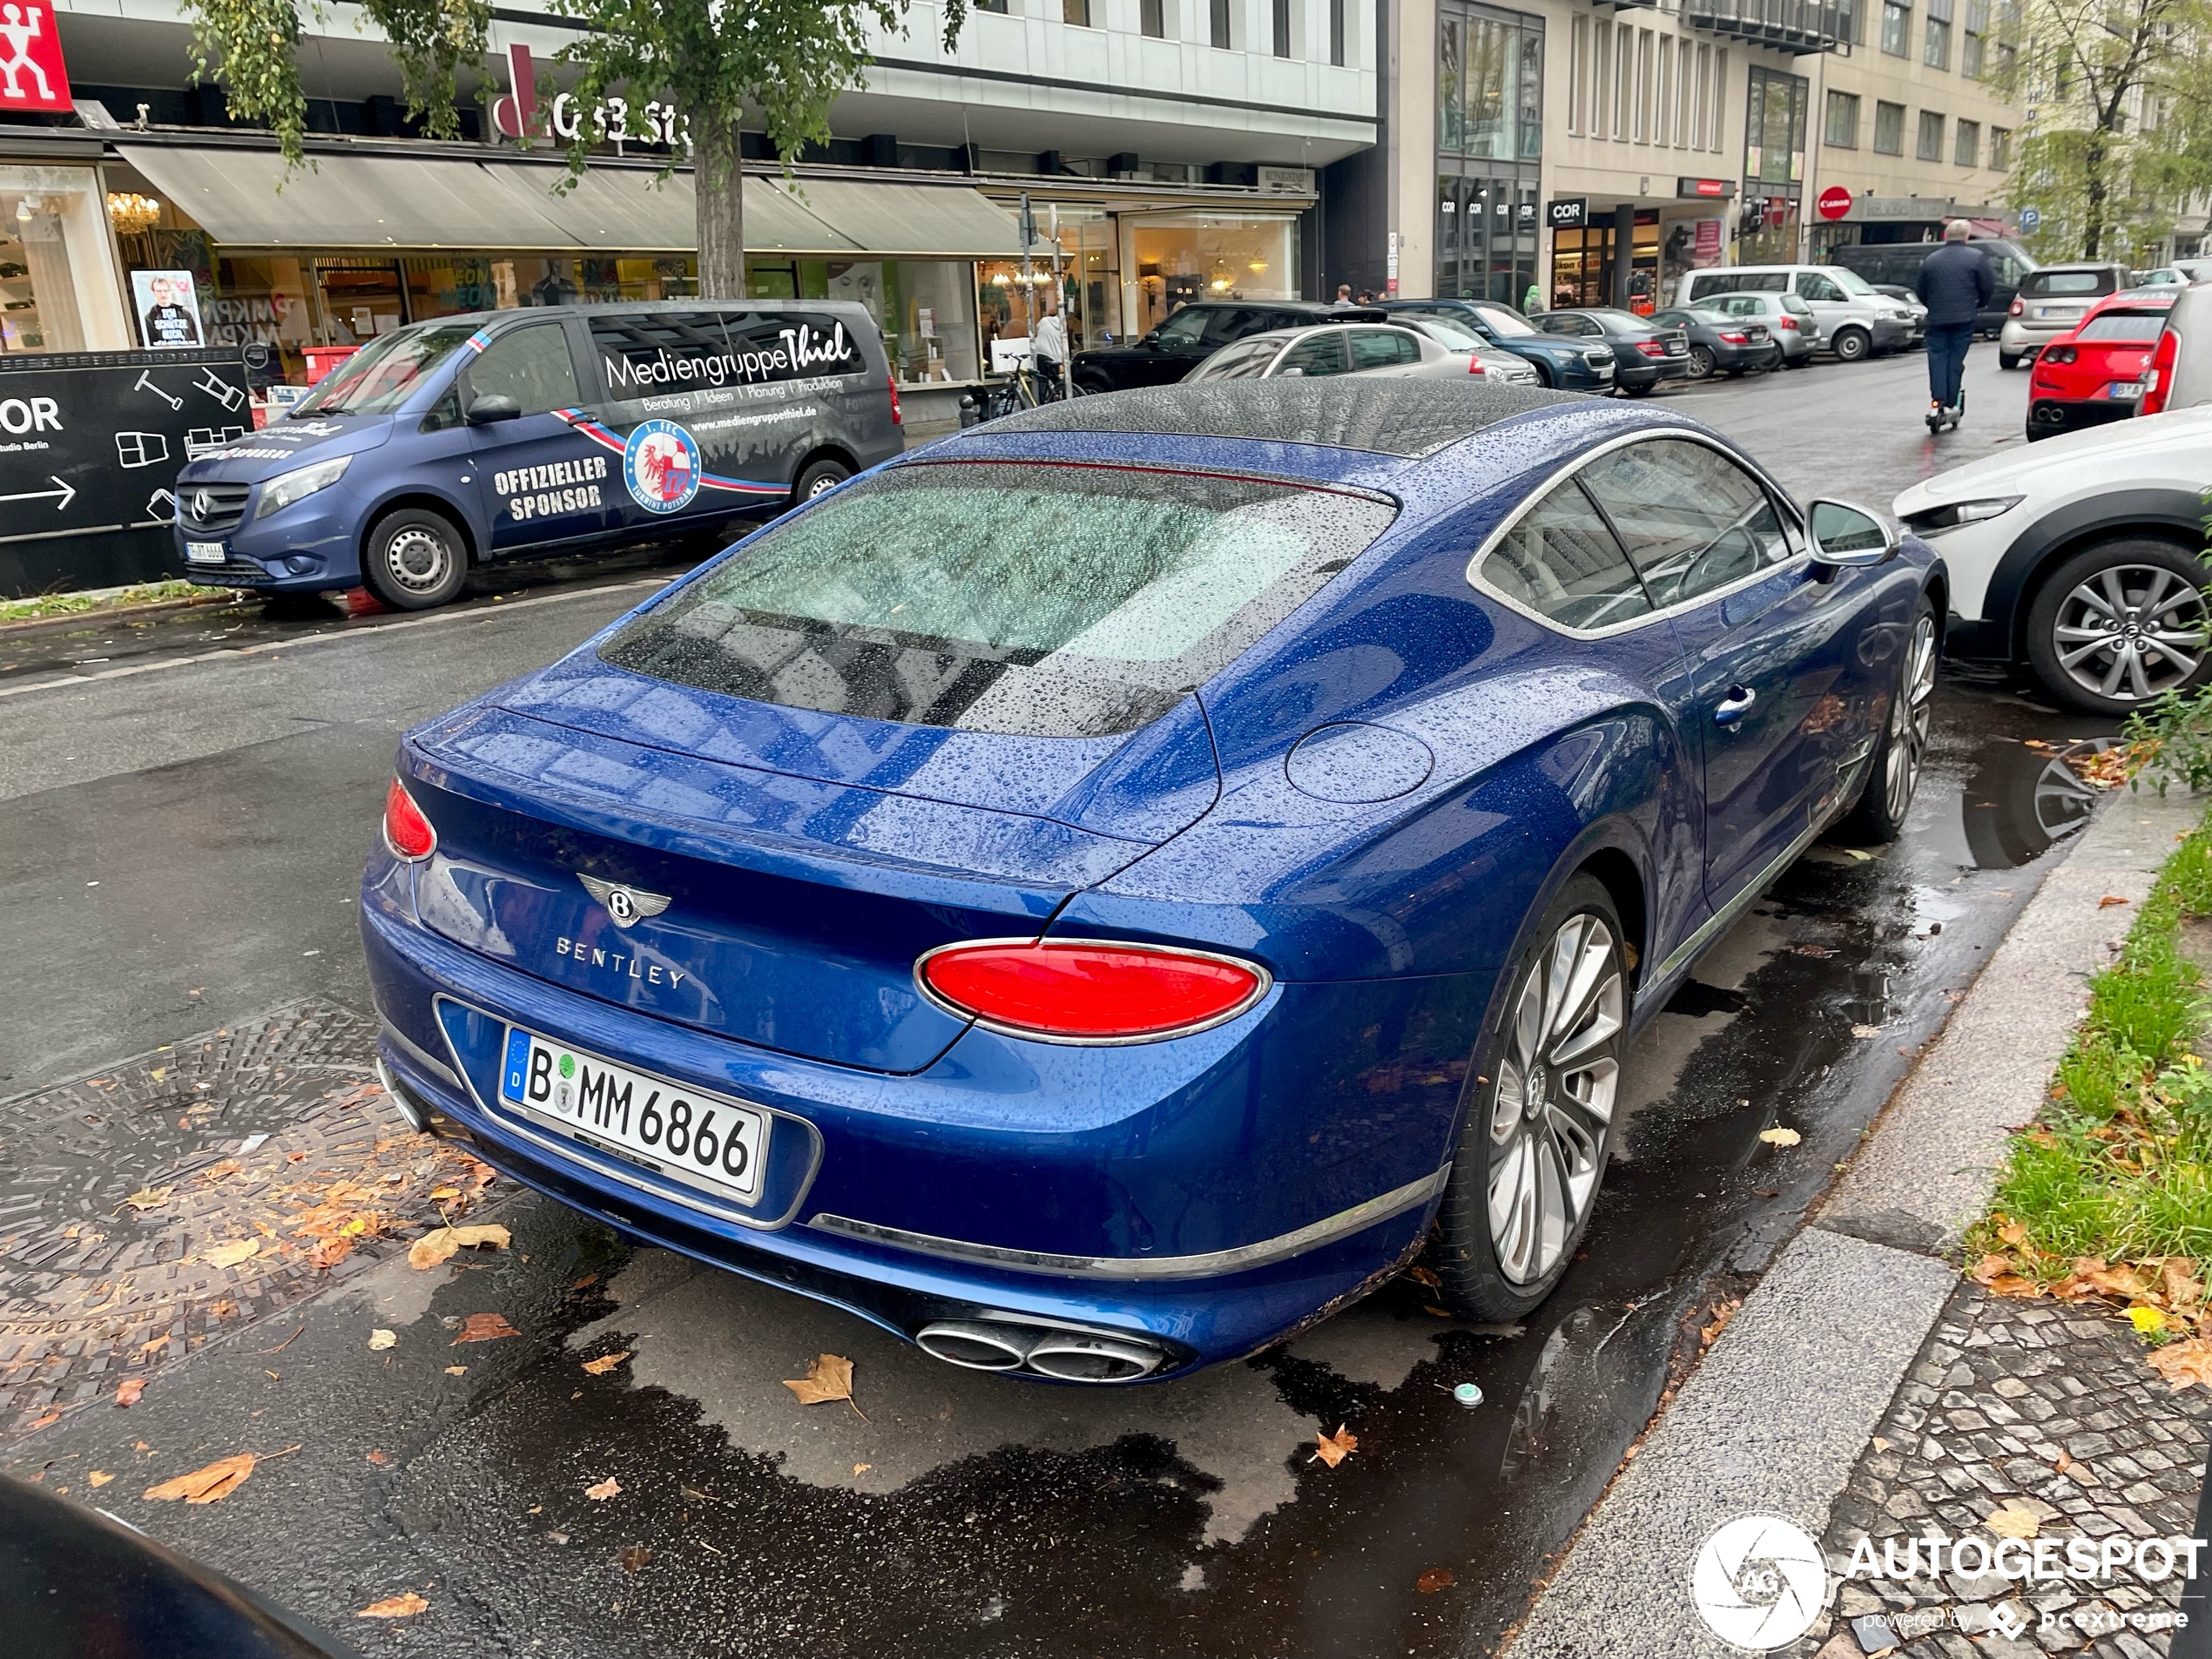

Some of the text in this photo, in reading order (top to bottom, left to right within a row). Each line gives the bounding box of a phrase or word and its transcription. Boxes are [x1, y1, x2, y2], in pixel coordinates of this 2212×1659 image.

[1442, 201, 1455, 212] COR
[1469, 203, 1481, 213] COR
[1496, 204, 1508, 215] COR
[1553, 203, 1581, 219] COR
[1820, 199, 1850, 208] Canon
[642, 378, 843, 412] Beratung Ideen Planung Produktion
[2117, 385, 2124, 395] B
[0, 396, 64, 434] OR
[691, 407, 817, 431] www.mediengruppethiel.de
[660, 422, 679, 435] FFC
[0, 441, 50, 452] tudio Berlin
[494, 456, 608, 496] OFFIZIELLER
[509, 484, 602, 521] SPONSOR
[631, 484, 694, 511] TURBINE POTSDAM
[556, 936, 685, 989] BENTLEY
[511, 1071, 520, 1088] D
[528, 1046, 748, 1177] B MM 6866
